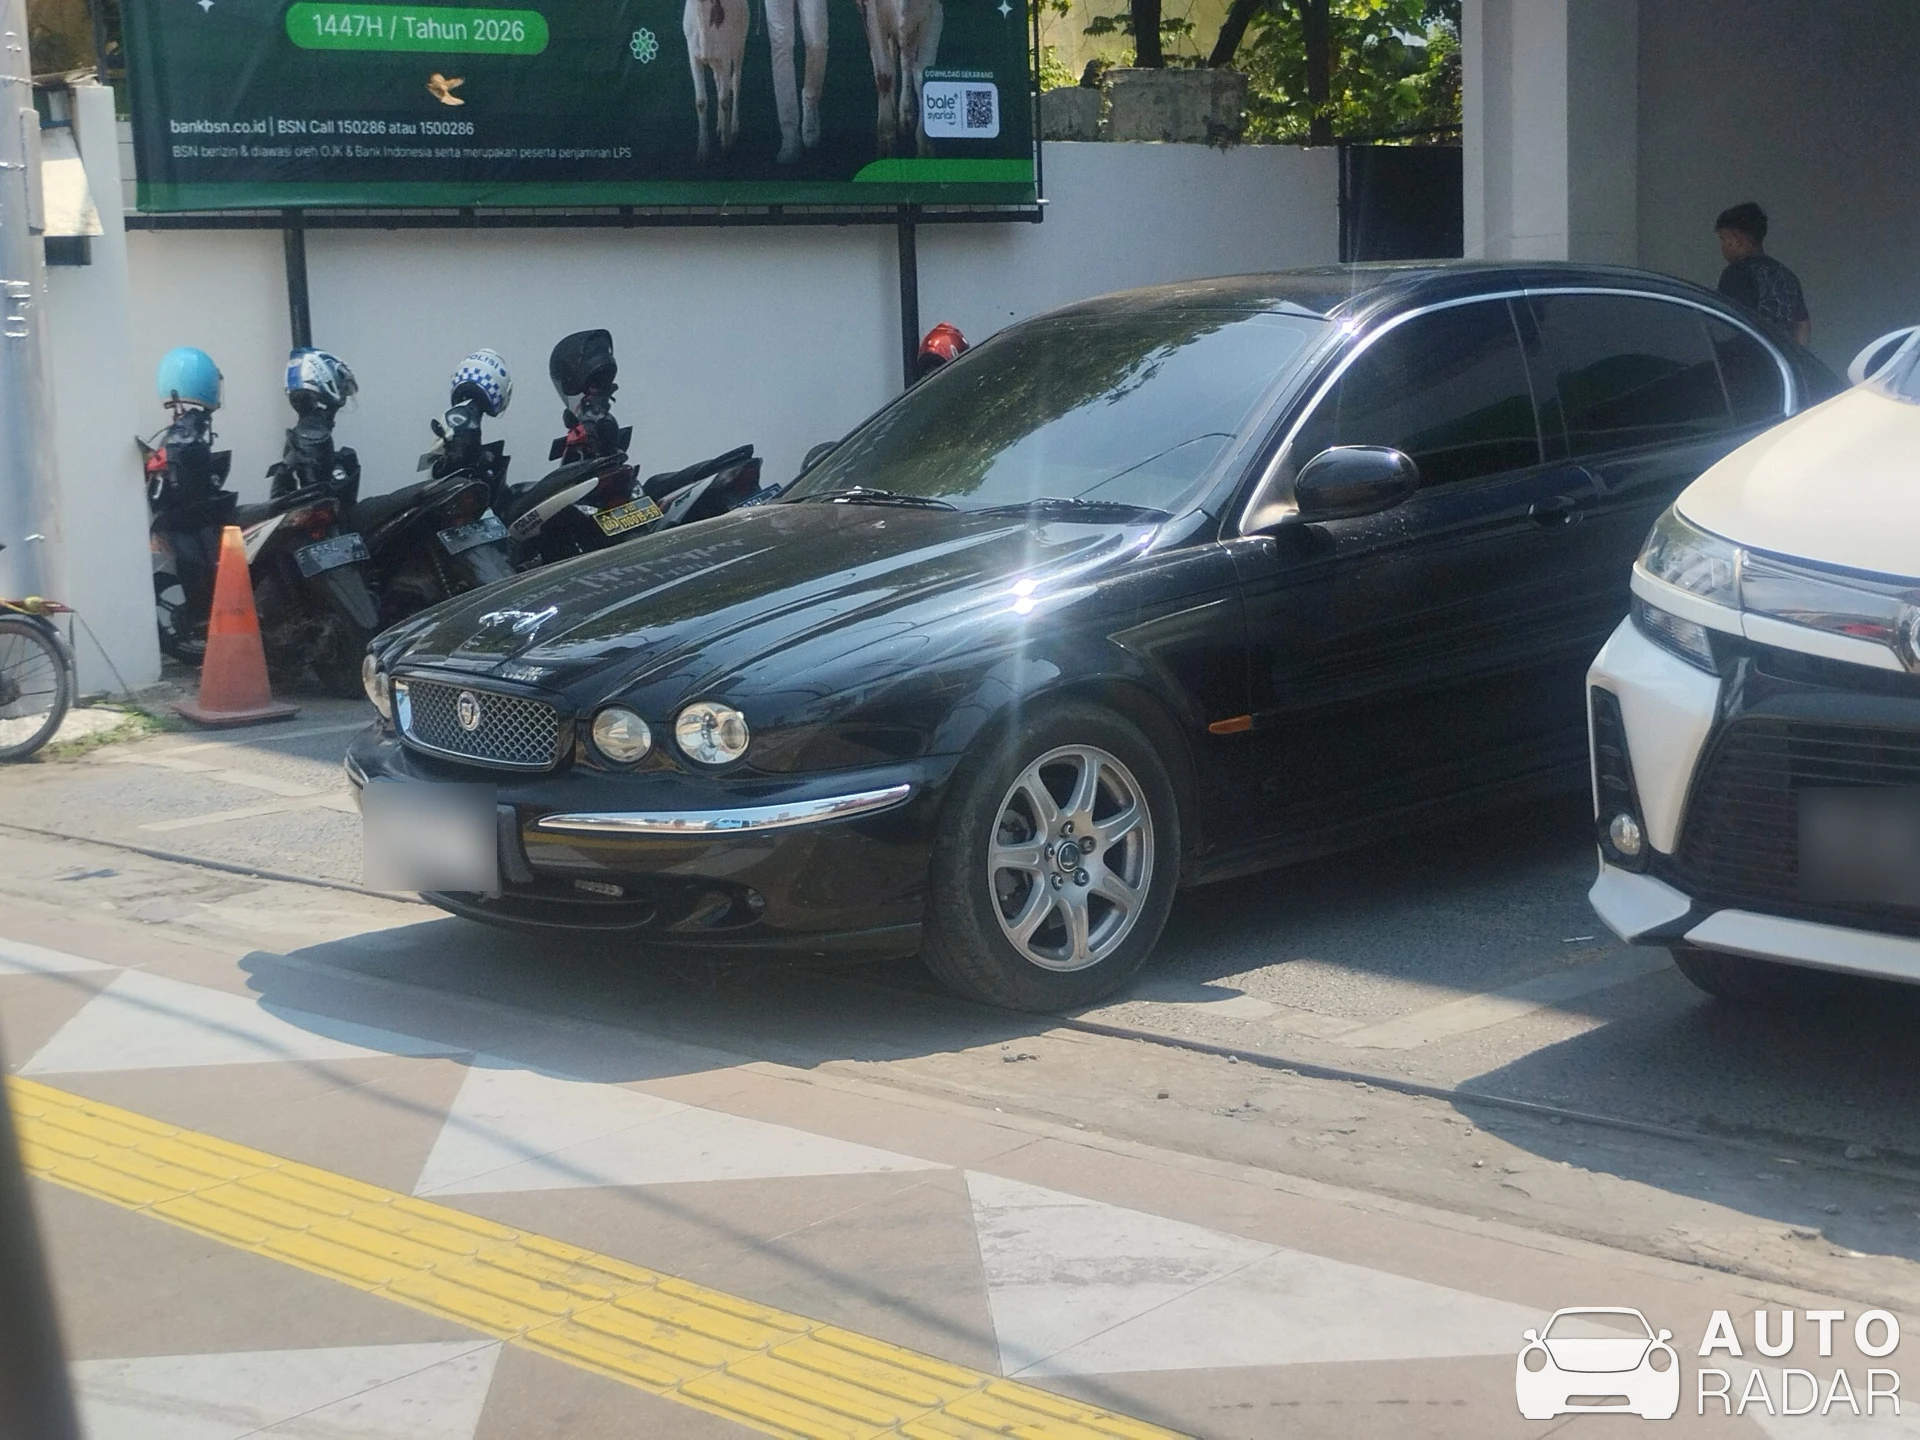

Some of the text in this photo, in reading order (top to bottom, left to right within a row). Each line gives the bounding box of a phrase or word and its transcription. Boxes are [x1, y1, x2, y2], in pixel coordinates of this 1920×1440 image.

[312, 13, 525, 42] 1447H / Tahun 2026
[926, 94, 955, 110] bale
[169, 119, 267, 134] bankbsn.co.id
[277, 120, 307, 134] BSN
[308, 120, 335, 134] Call
[336, 120, 386, 134] 150286
[388, 122, 417, 134] atau
[419, 121, 475, 135] 1500286
[172, 145, 199, 158] BSN
[612, 148, 632, 159] LPS
[466, 354, 499, 369] OLISI
